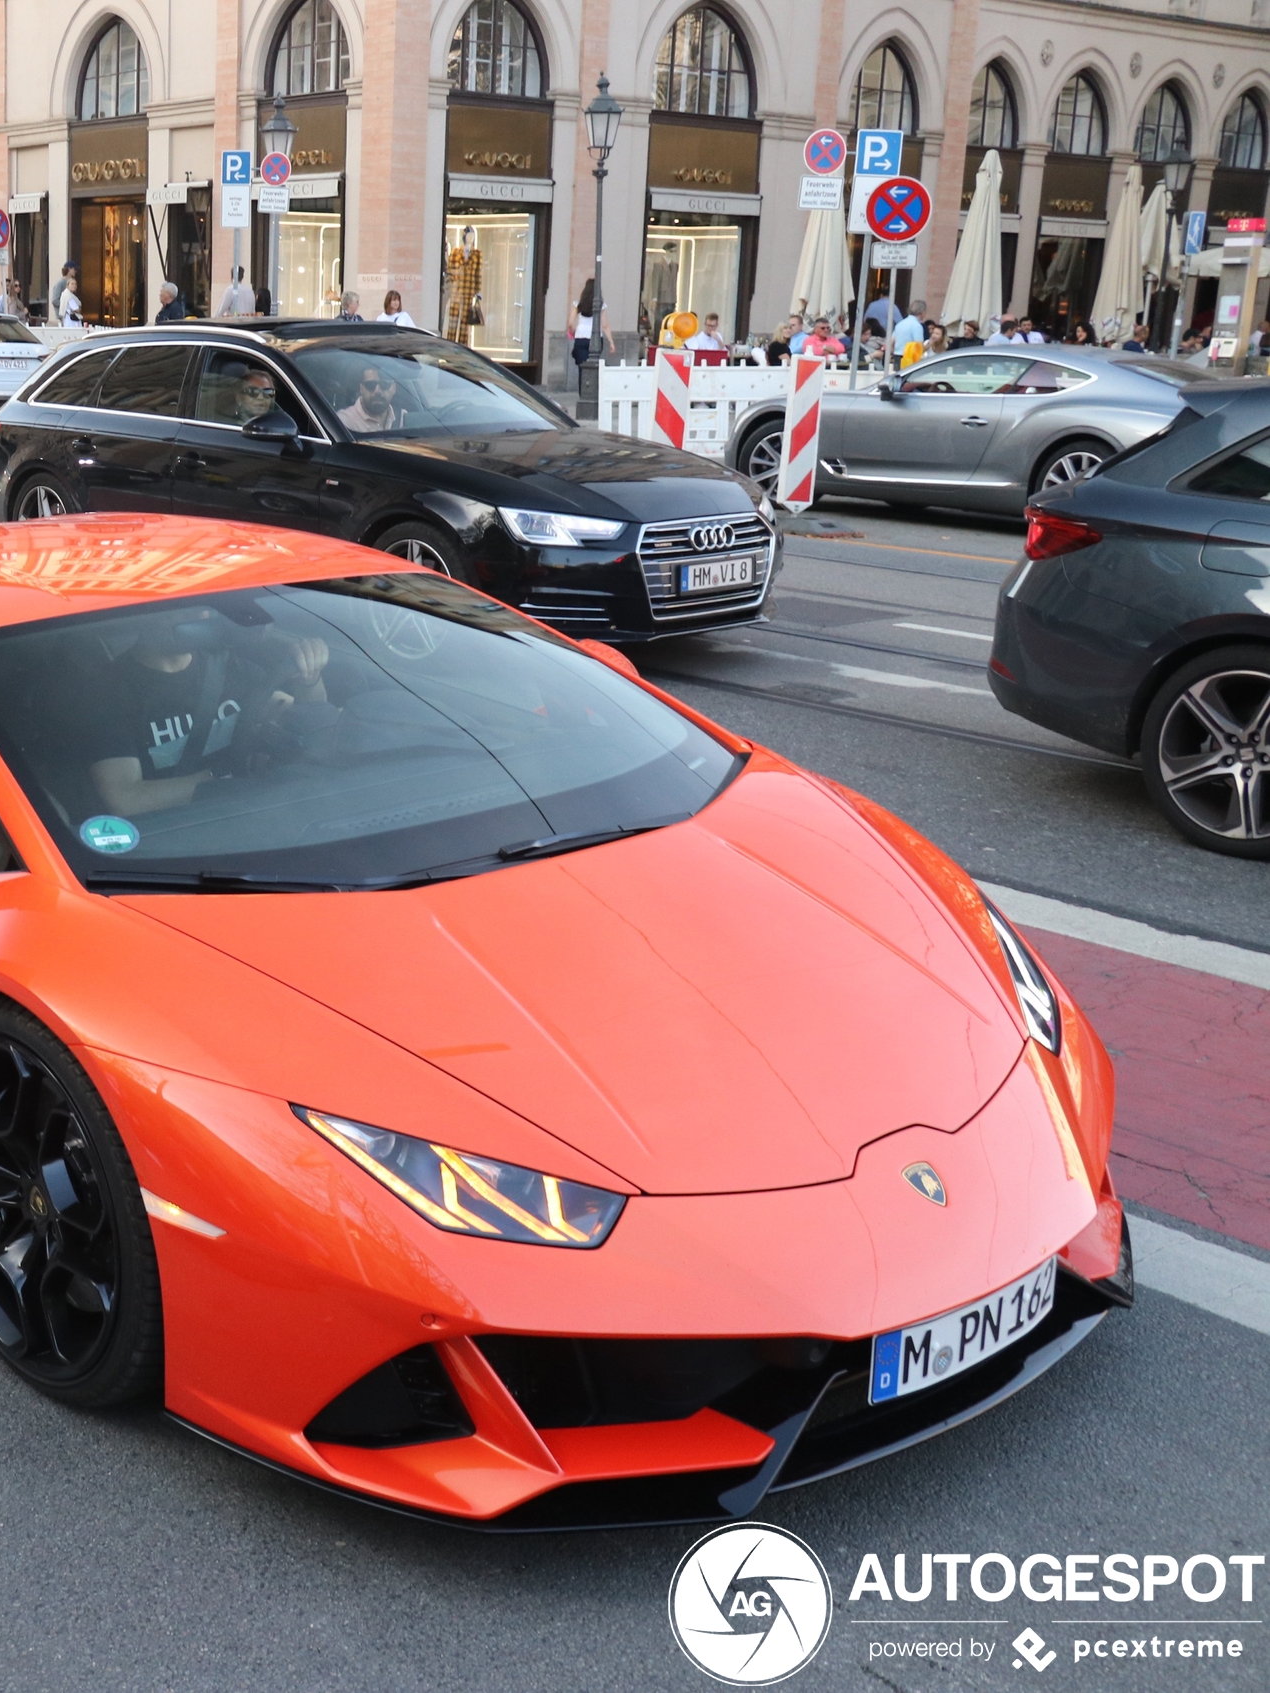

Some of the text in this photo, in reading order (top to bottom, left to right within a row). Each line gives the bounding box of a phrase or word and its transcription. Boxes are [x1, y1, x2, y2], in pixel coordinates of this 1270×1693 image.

[863, 136, 888, 170] P
[72, 158, 143, 182] GUCCI
[226, 155, 242, 181] P
[152, 191, 182, 200] GUCCI
[480, 184, 525, 198] GUCCI
[13, 200, 36, 210] GUCCI
[688, 199, 726, 211] GUCCI
[693, 561, 747, 587] HM VI 8
[902, 1263, 1054, 1384] M PN 162
[880, 1373, 891, 1389] D
